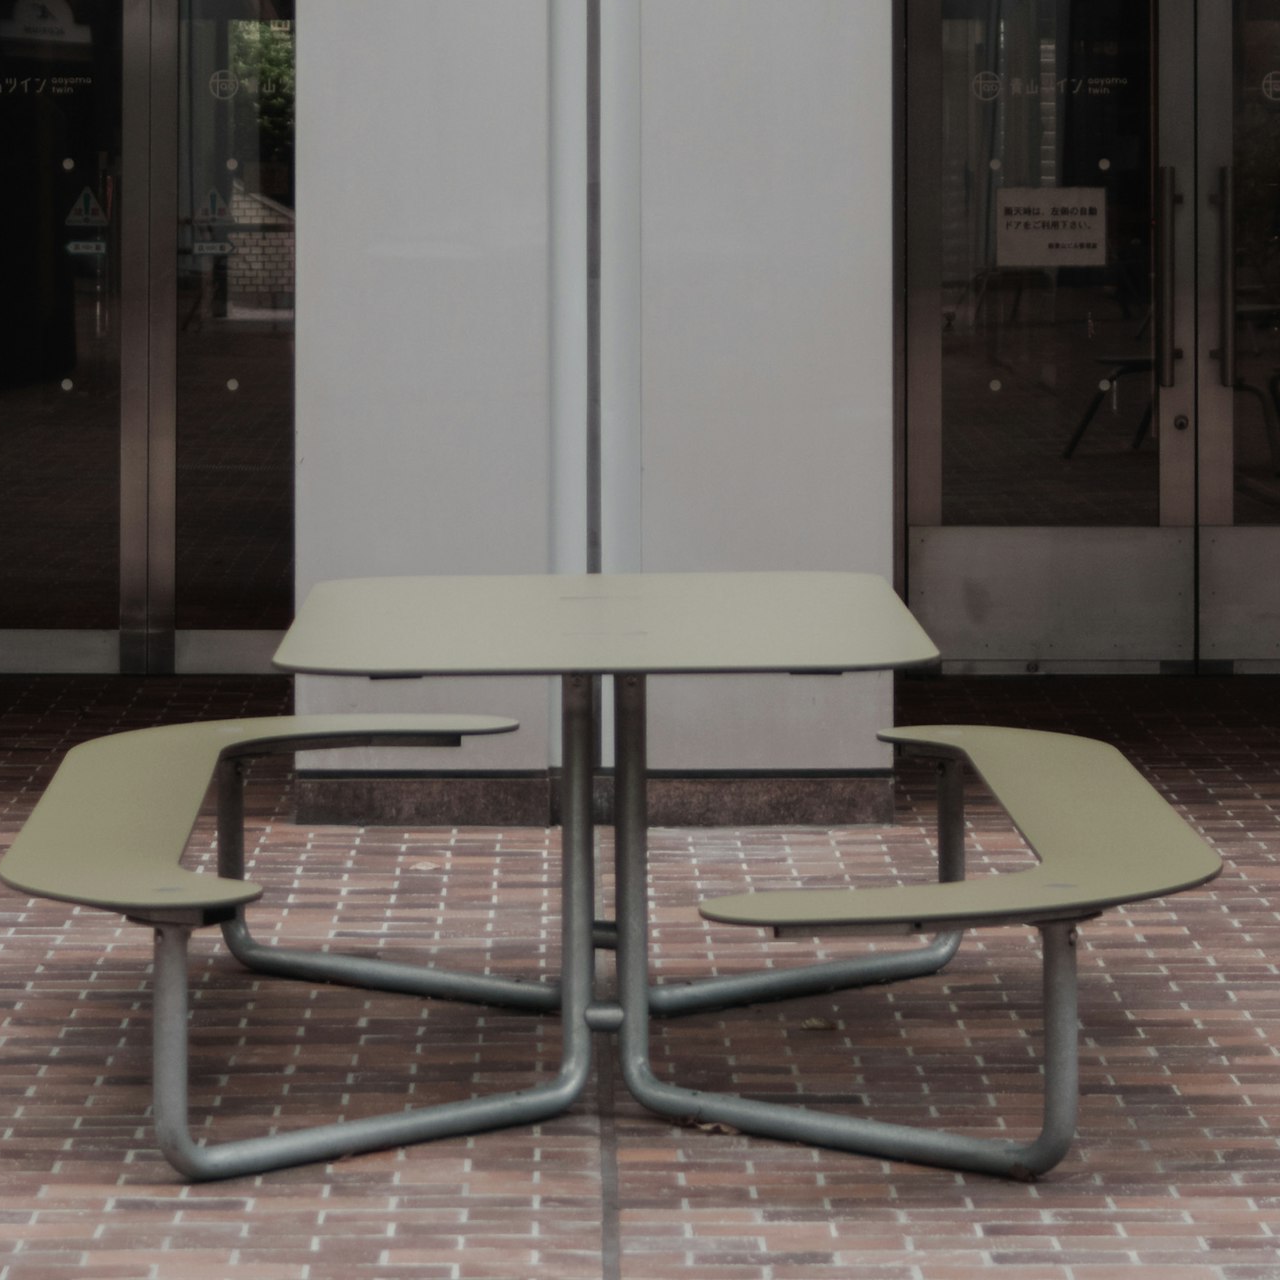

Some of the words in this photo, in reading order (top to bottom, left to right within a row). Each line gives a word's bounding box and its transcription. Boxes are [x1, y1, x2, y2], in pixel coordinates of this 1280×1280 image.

[51, 76, 93, 87] aoyama
[1087, 77, 1129, 88] aoyama
[51, 86, 75, 95] twin
[1087, 87, 1111, 95] twin
